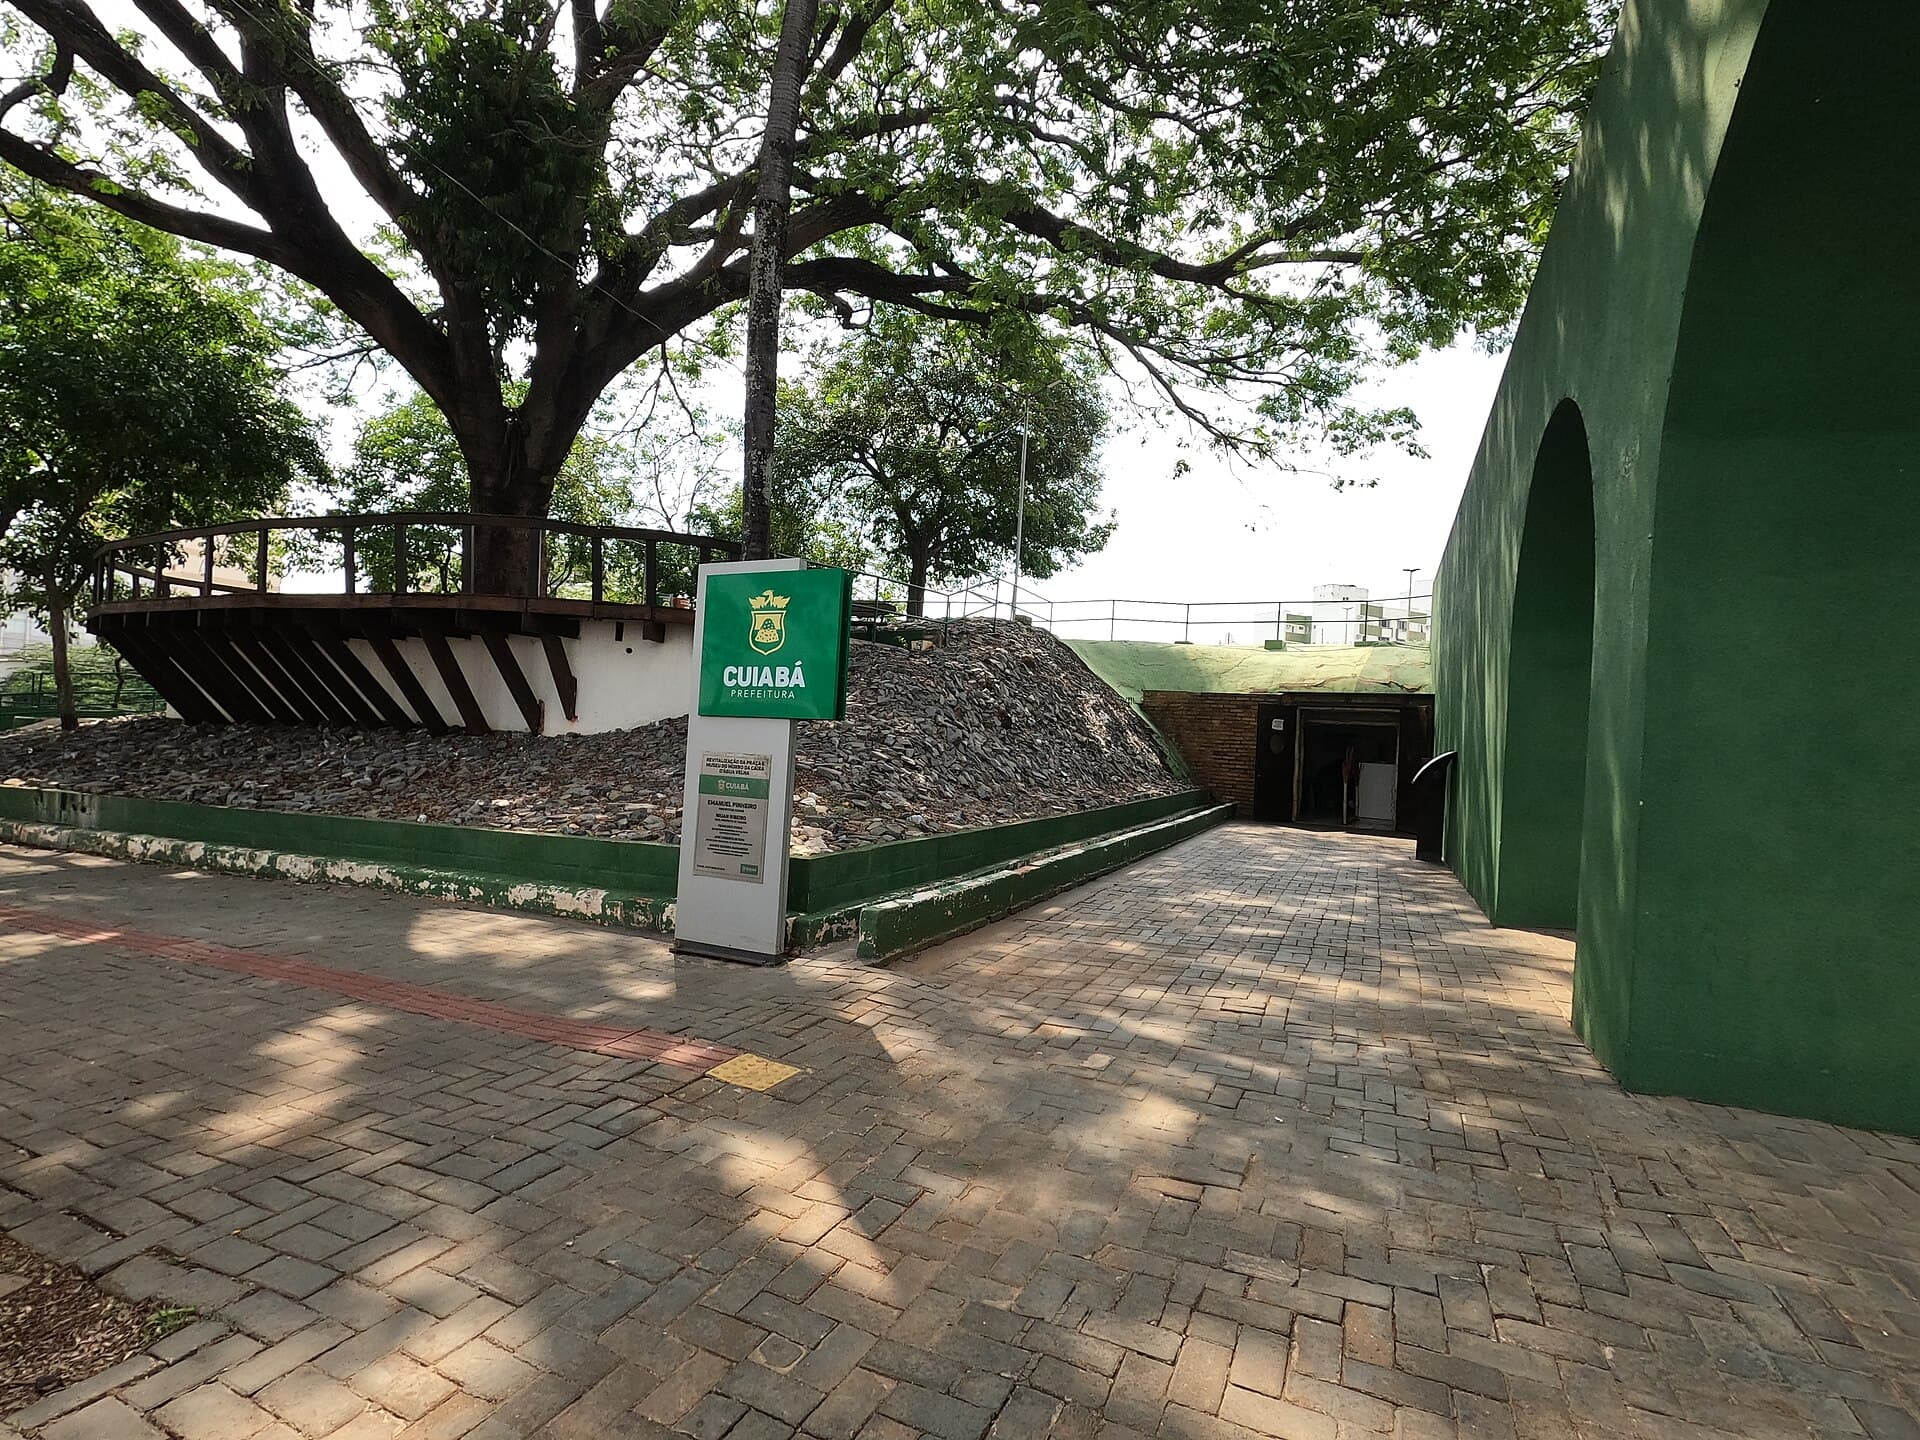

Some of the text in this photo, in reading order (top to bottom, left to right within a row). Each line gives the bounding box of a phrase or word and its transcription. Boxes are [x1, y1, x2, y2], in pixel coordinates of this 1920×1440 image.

[723, 660, 806, 688] CUIABÁ
[730, 689, 796, 699] PREFEITURA
[725, 782, 749, 790] CUIABÁ
[707, 800, 732, 808] EMANUEL
[733, 802, 757, 810] PINHEIRO
